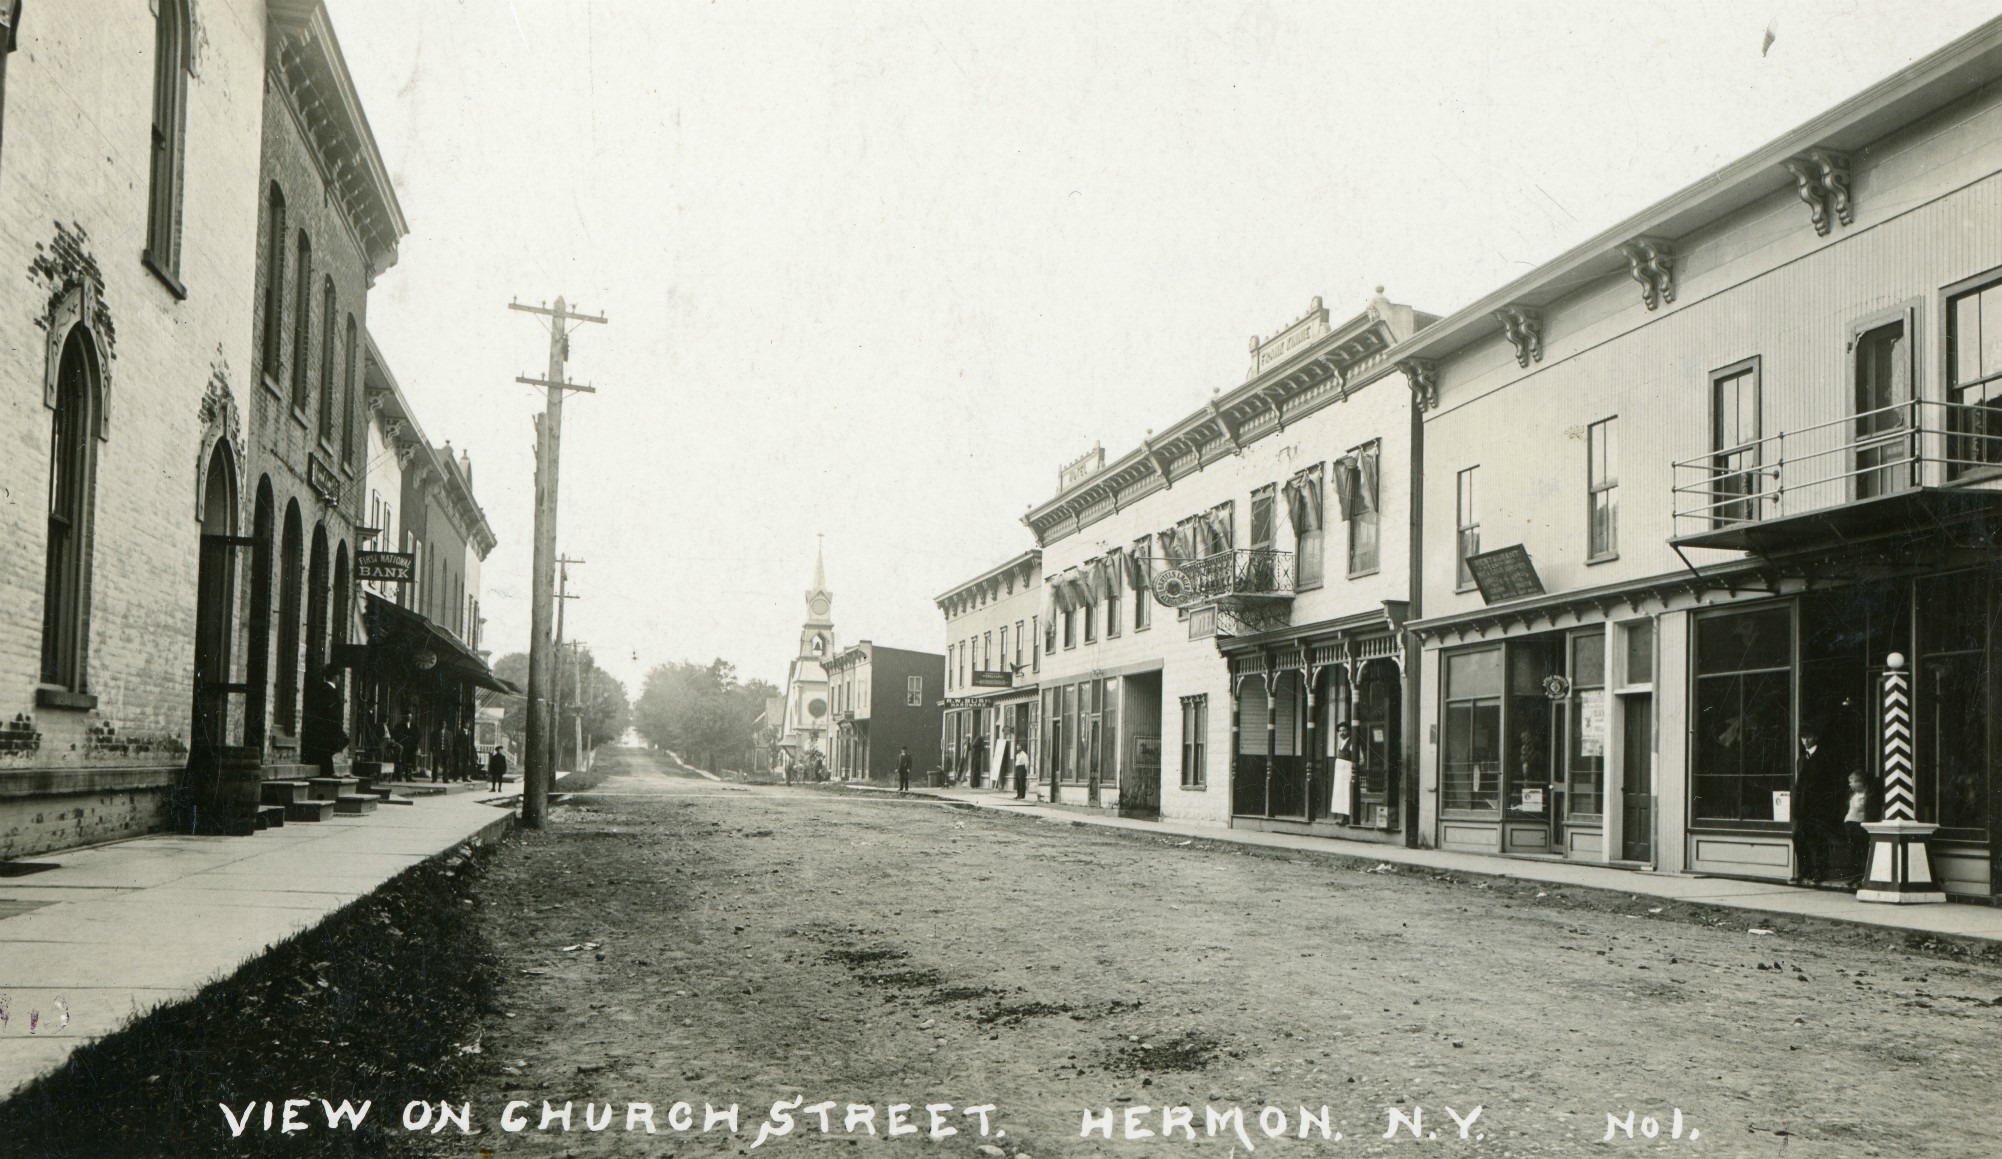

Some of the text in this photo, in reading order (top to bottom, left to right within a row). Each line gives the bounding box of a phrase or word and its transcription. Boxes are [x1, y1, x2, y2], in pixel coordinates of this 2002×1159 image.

[358, 554, 412, 569] FIRST NATIONAL
[359, 566, 409, 579] BANK
